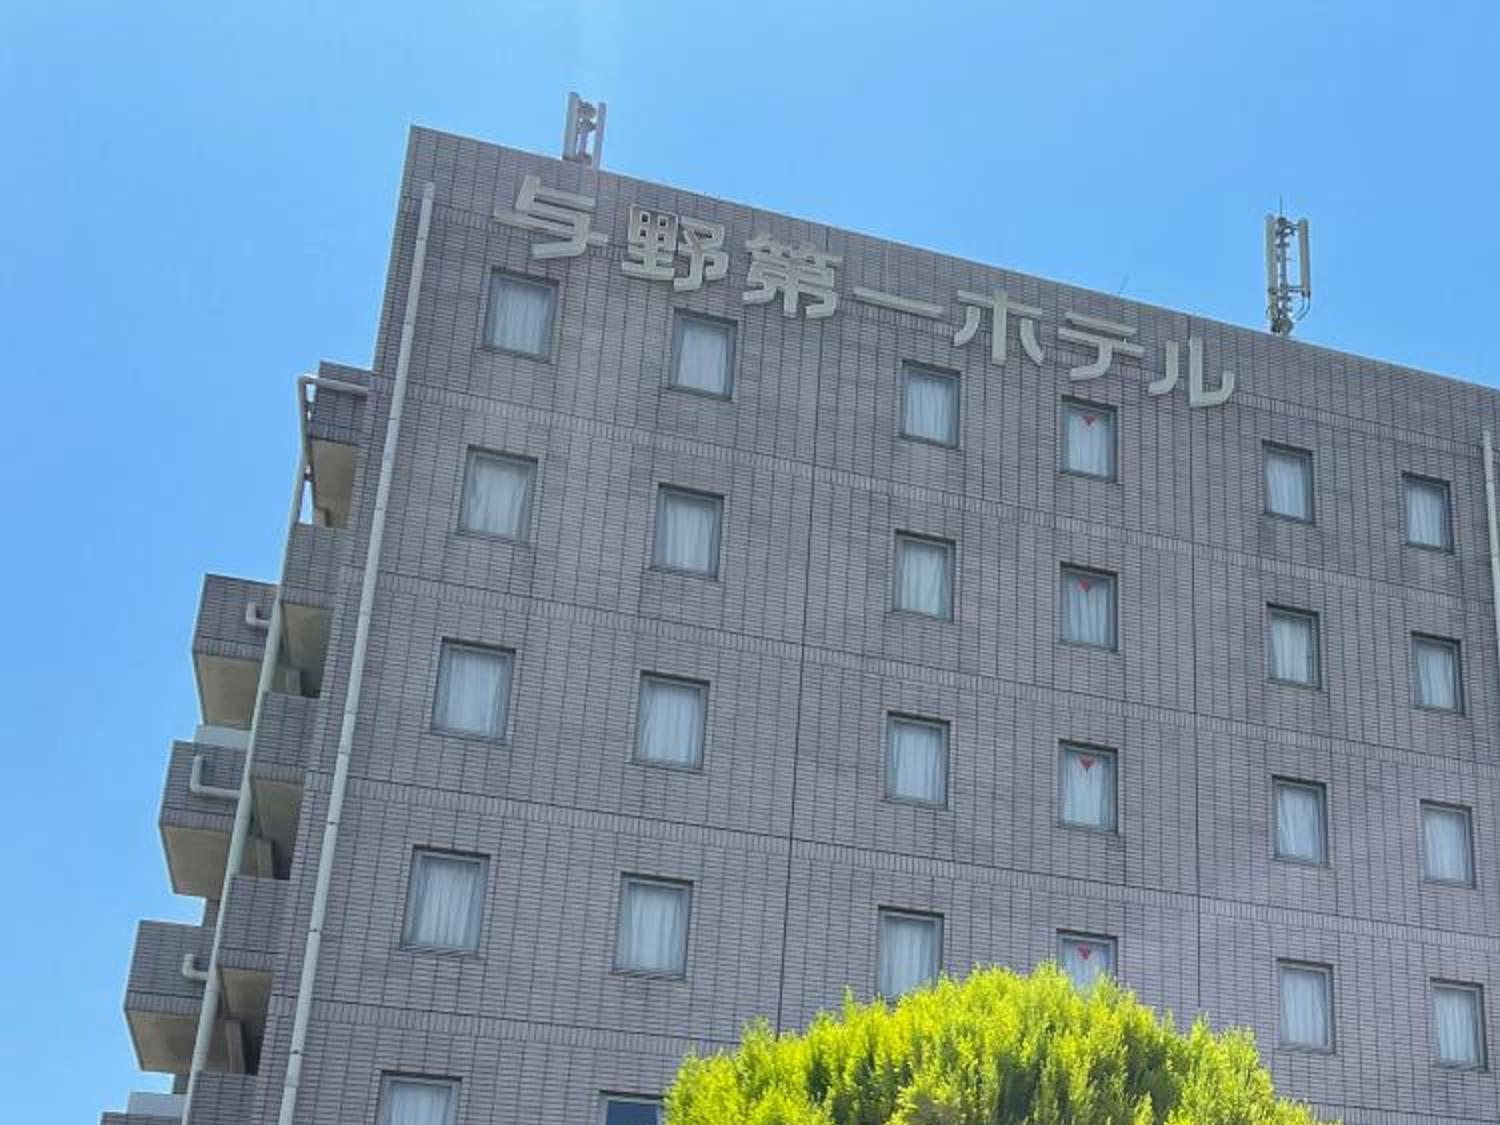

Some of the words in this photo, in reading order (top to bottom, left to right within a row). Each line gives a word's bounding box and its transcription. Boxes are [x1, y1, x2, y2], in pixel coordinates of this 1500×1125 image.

[492, 174, 1236, 408] 与野第一ホテル
